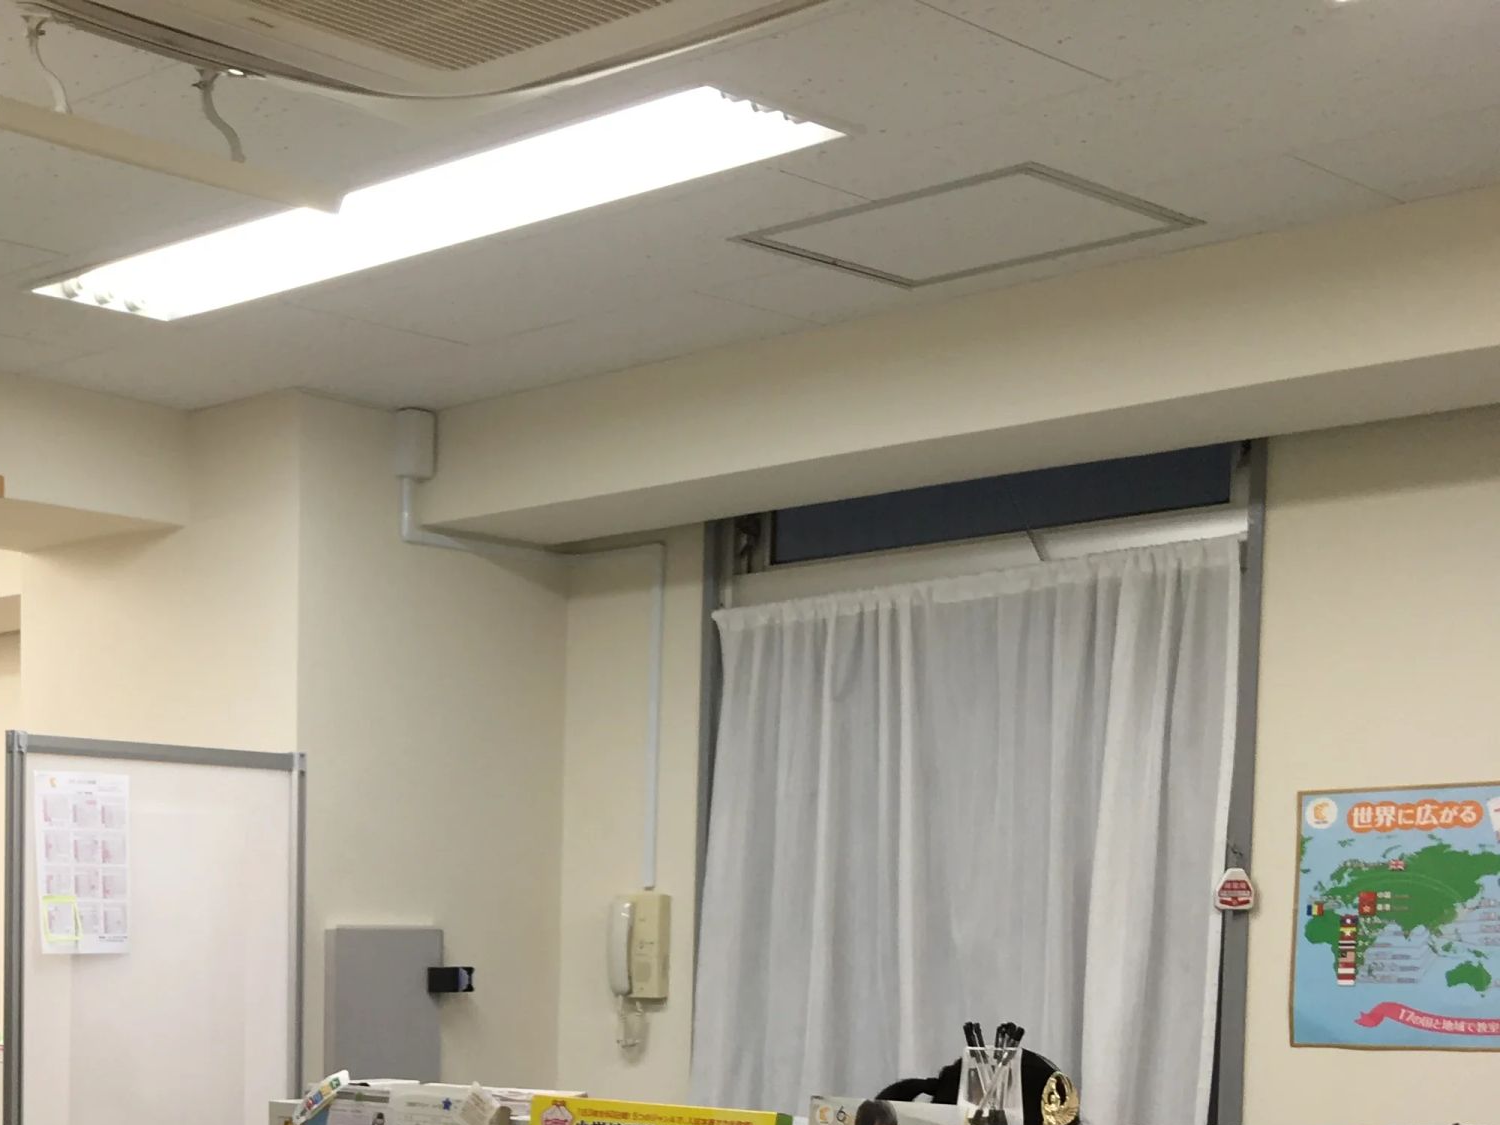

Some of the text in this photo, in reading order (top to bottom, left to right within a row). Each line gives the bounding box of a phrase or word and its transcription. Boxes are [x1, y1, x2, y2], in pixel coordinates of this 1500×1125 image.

[1352, 804, 1478, 828] 世界に広がる
